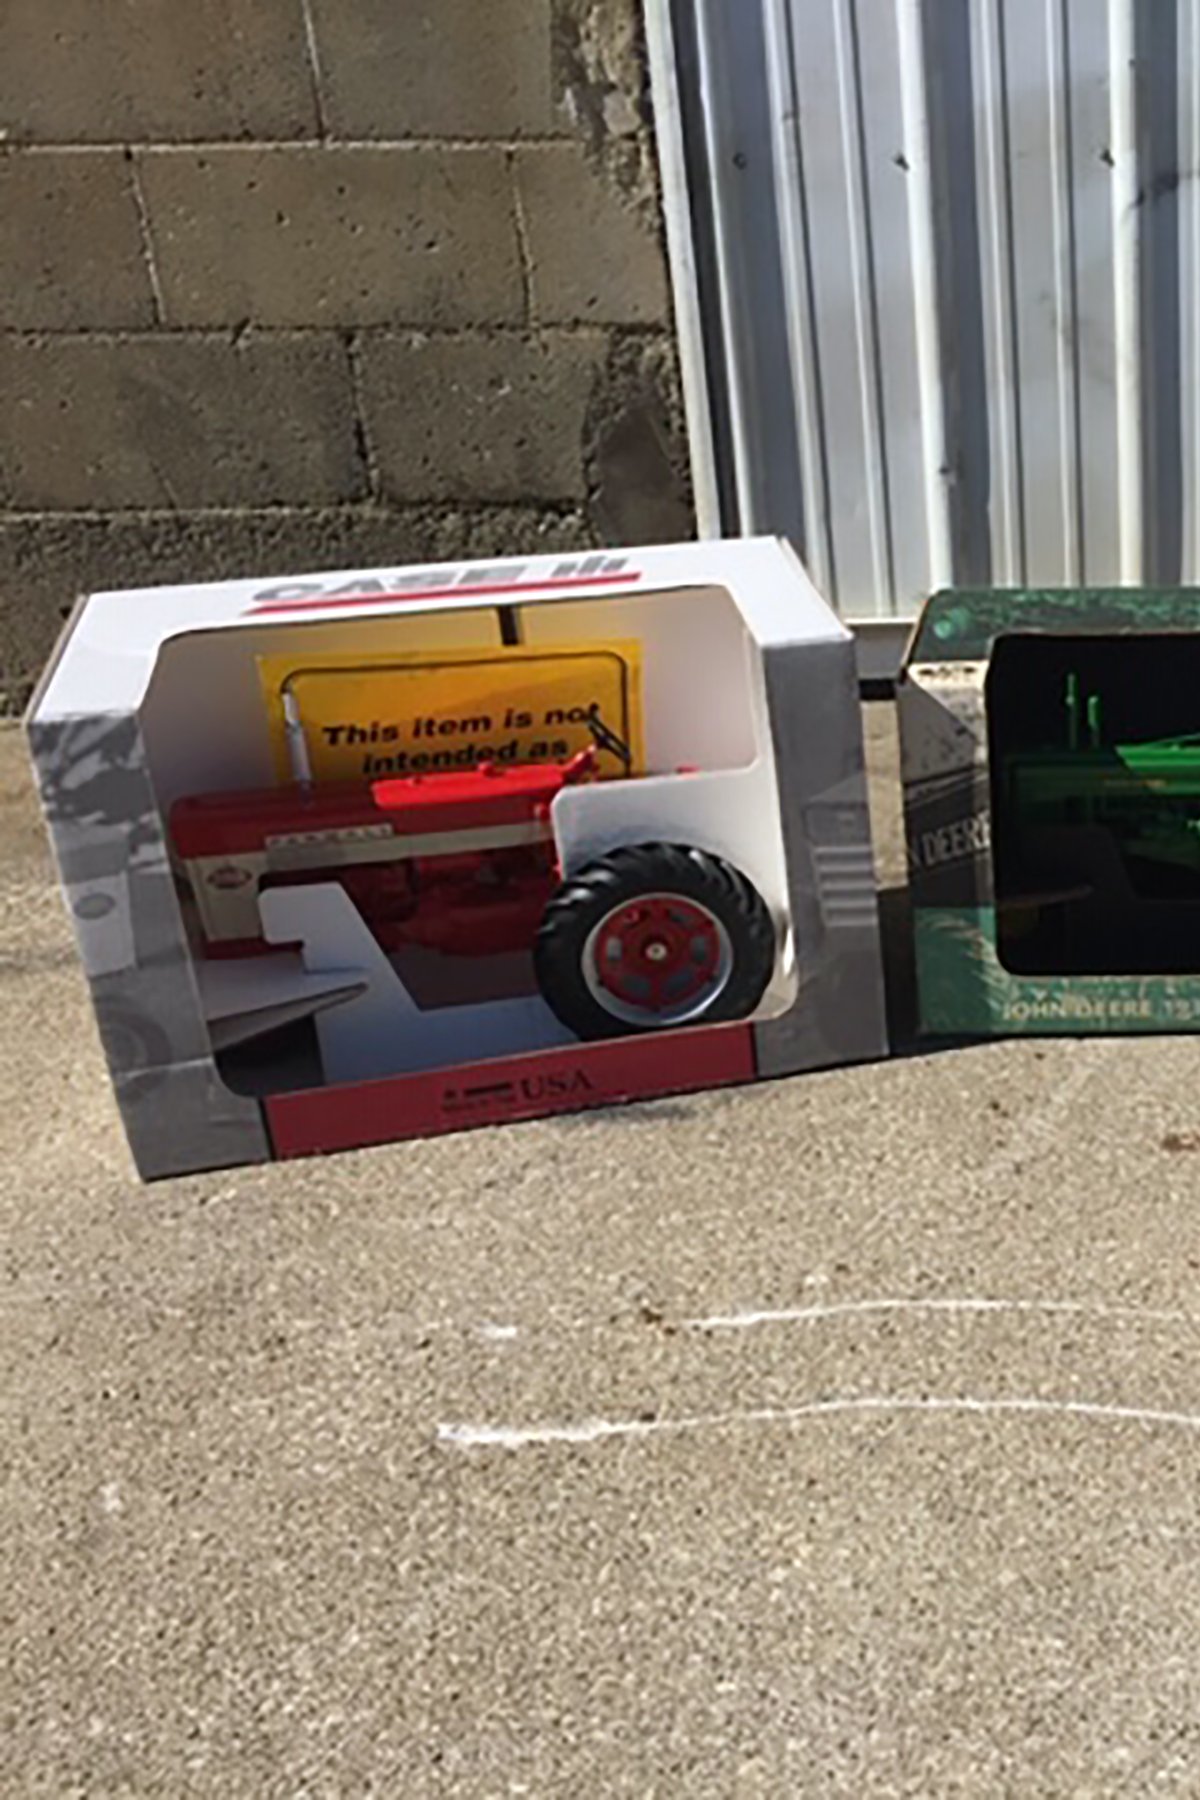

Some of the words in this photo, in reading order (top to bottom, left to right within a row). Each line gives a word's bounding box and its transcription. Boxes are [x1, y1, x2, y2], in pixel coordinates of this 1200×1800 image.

[322, 720, 399, 746] This
[413, 711, 492, 738] item
[504, 708, 533, 729] is
[362, 740, 517, 774] intended
[528, 738, 568, 757] as
[520, 1068, 594, 1101] USA
